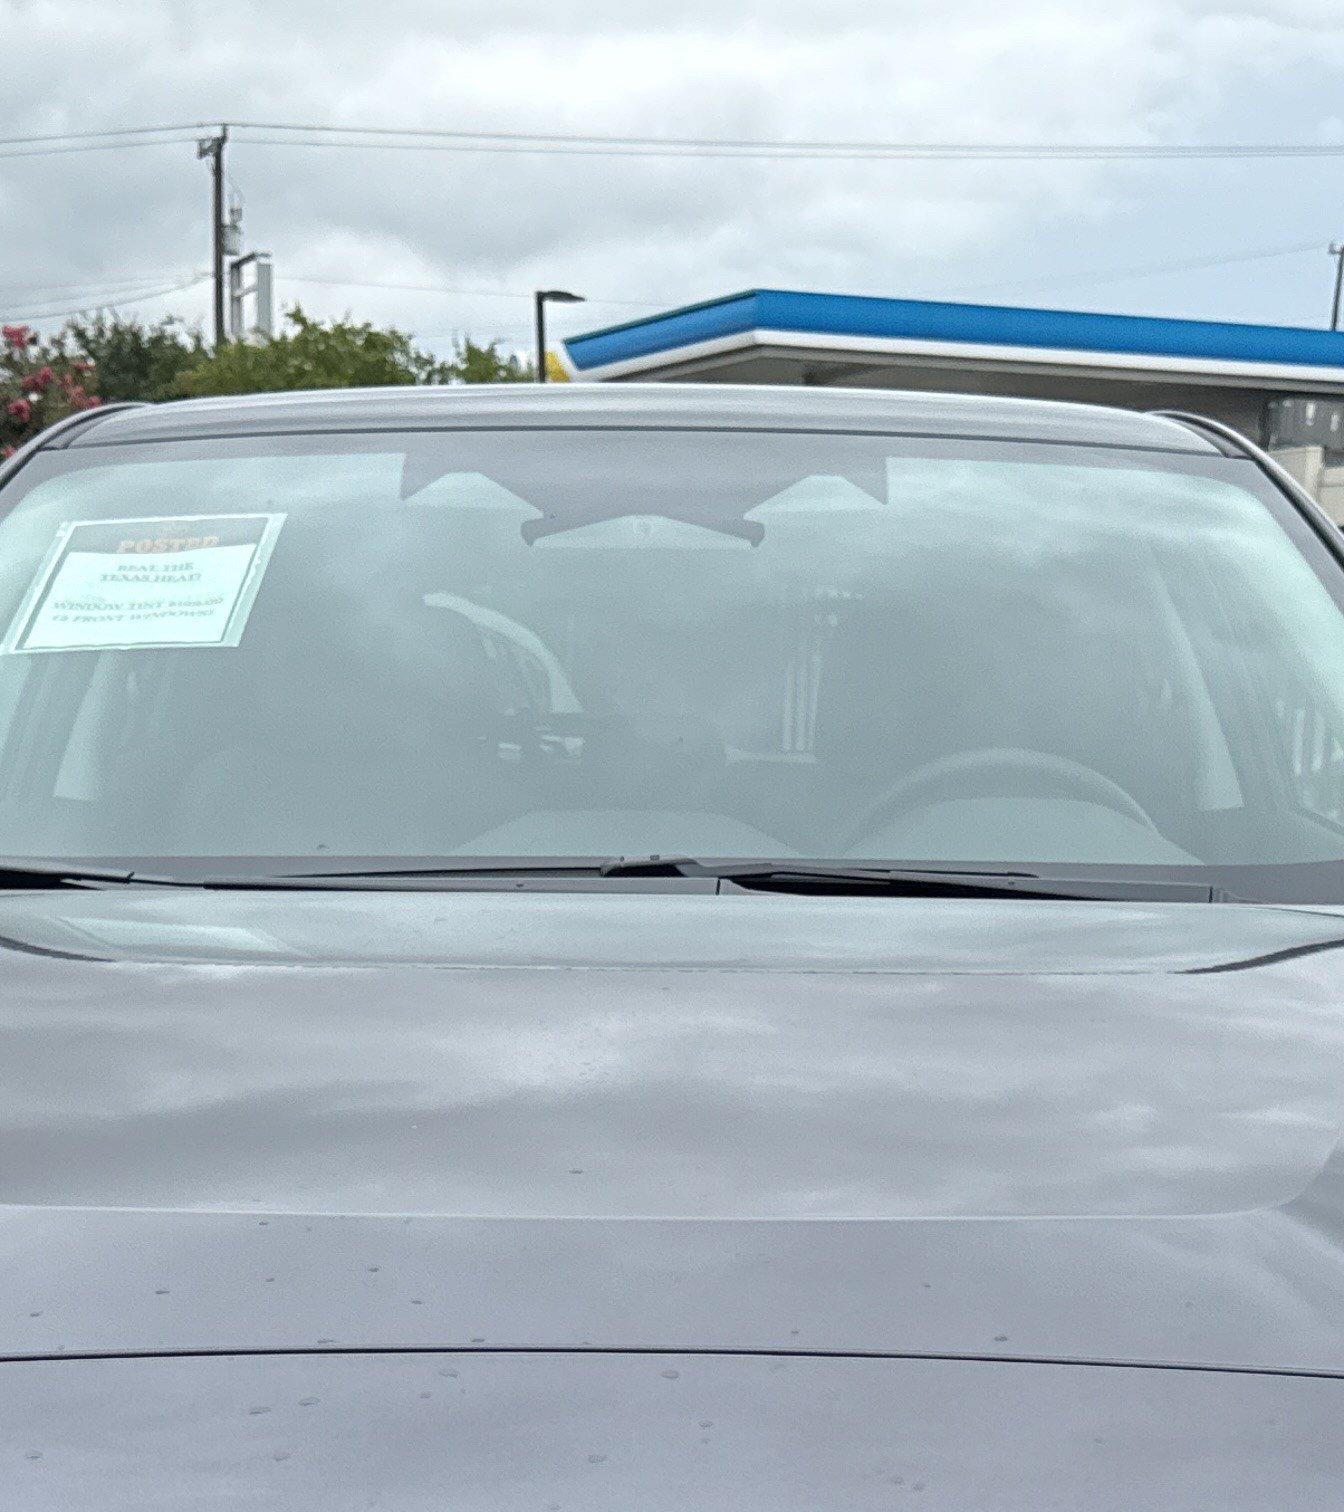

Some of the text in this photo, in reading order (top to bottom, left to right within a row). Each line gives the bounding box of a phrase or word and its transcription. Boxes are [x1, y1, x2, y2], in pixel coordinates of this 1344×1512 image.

[100, 574, 152, 583] TEXAS
[54, 601, 123, 611] WINDOW
[127, 600, 164, 610] TINT
